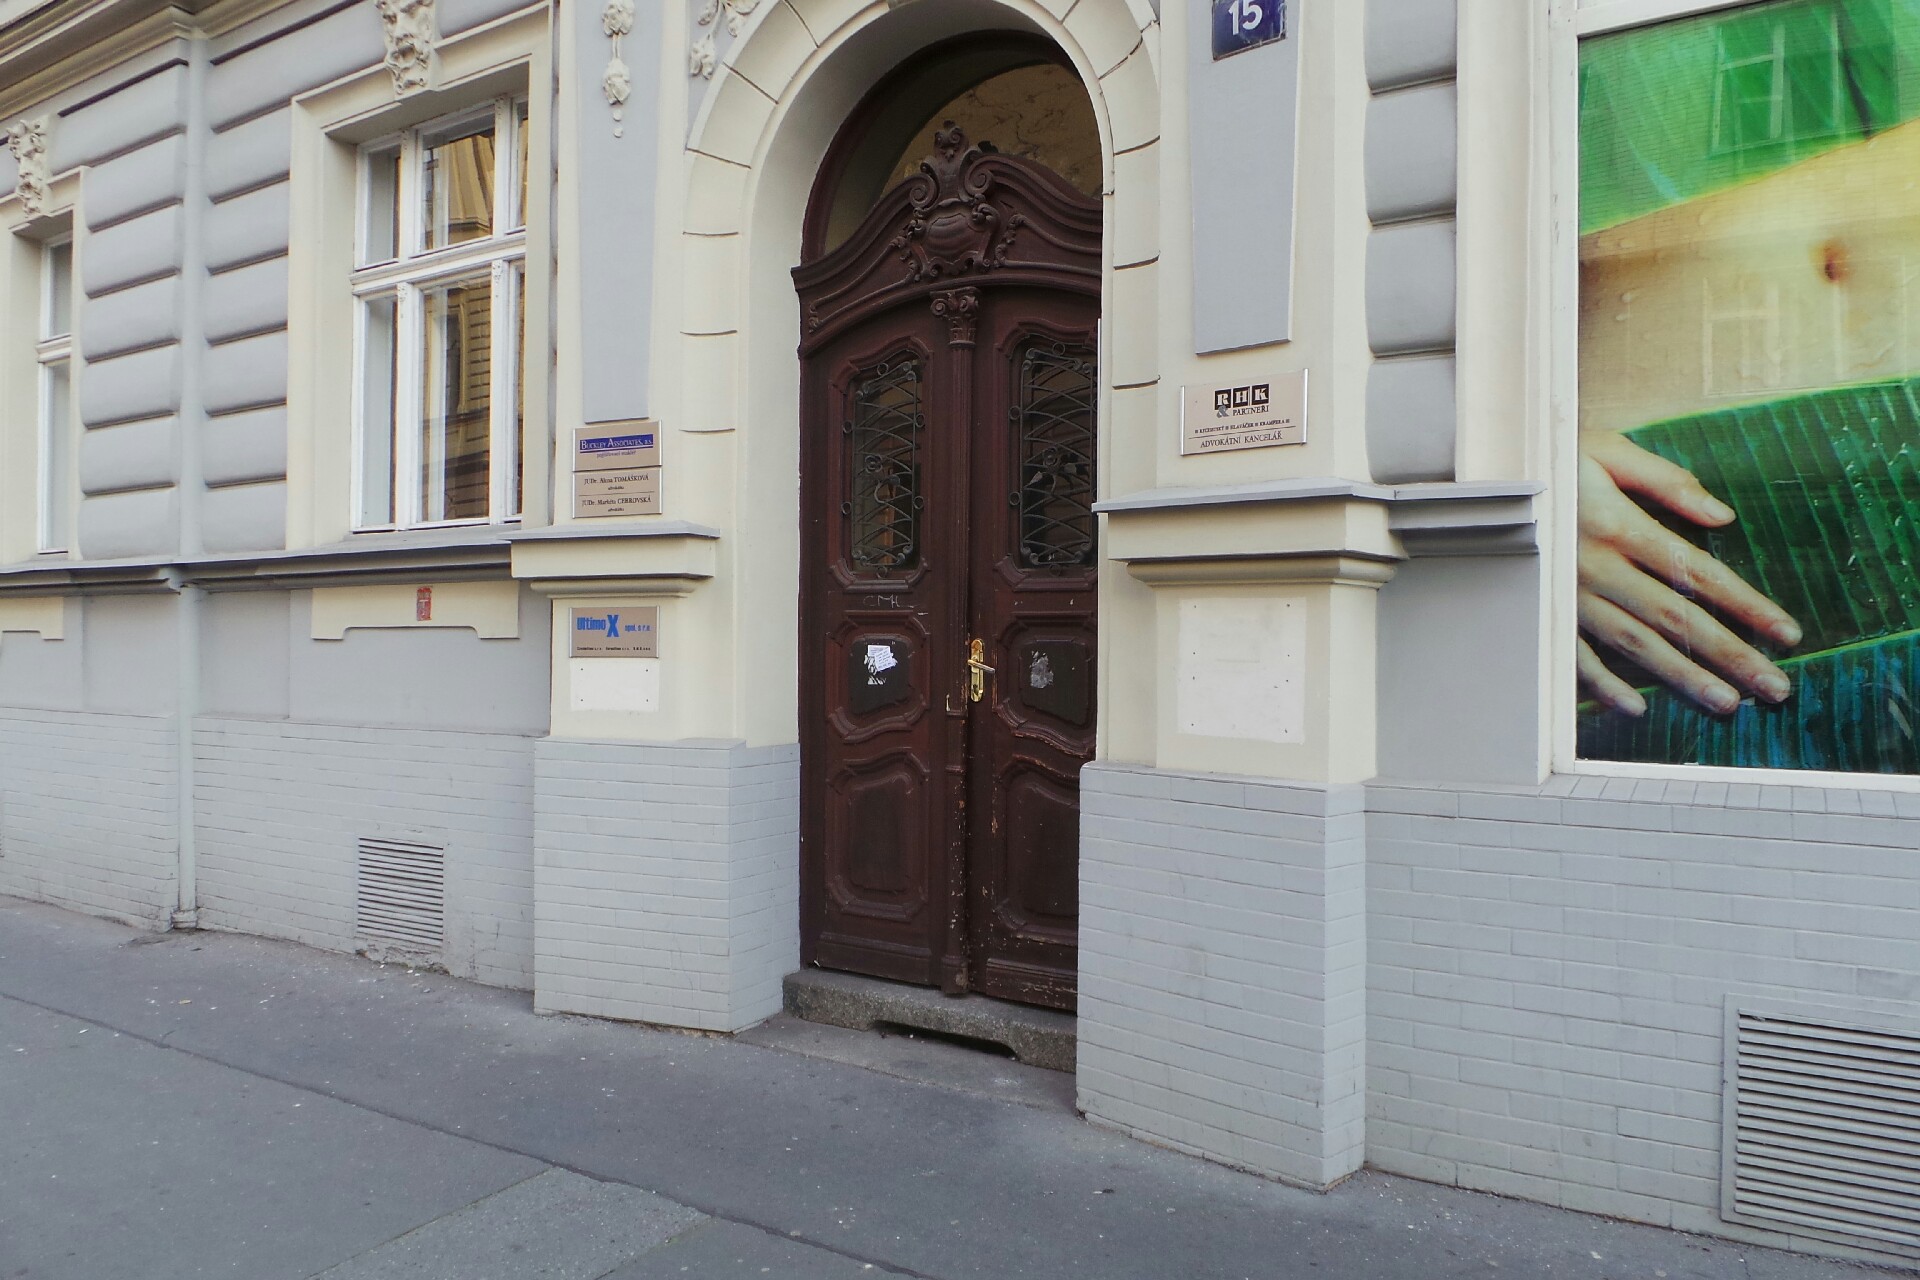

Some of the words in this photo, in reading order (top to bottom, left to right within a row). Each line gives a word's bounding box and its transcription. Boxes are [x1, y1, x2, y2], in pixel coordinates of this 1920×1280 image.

[1228, 0, 1263, 36] 15
[1216, 386, 1268, 406] RHK
[1200, 435, 1241, 448] ADVOKÁTNÍ
[1244, 430, 1283, 443] KANCELÁŘ
